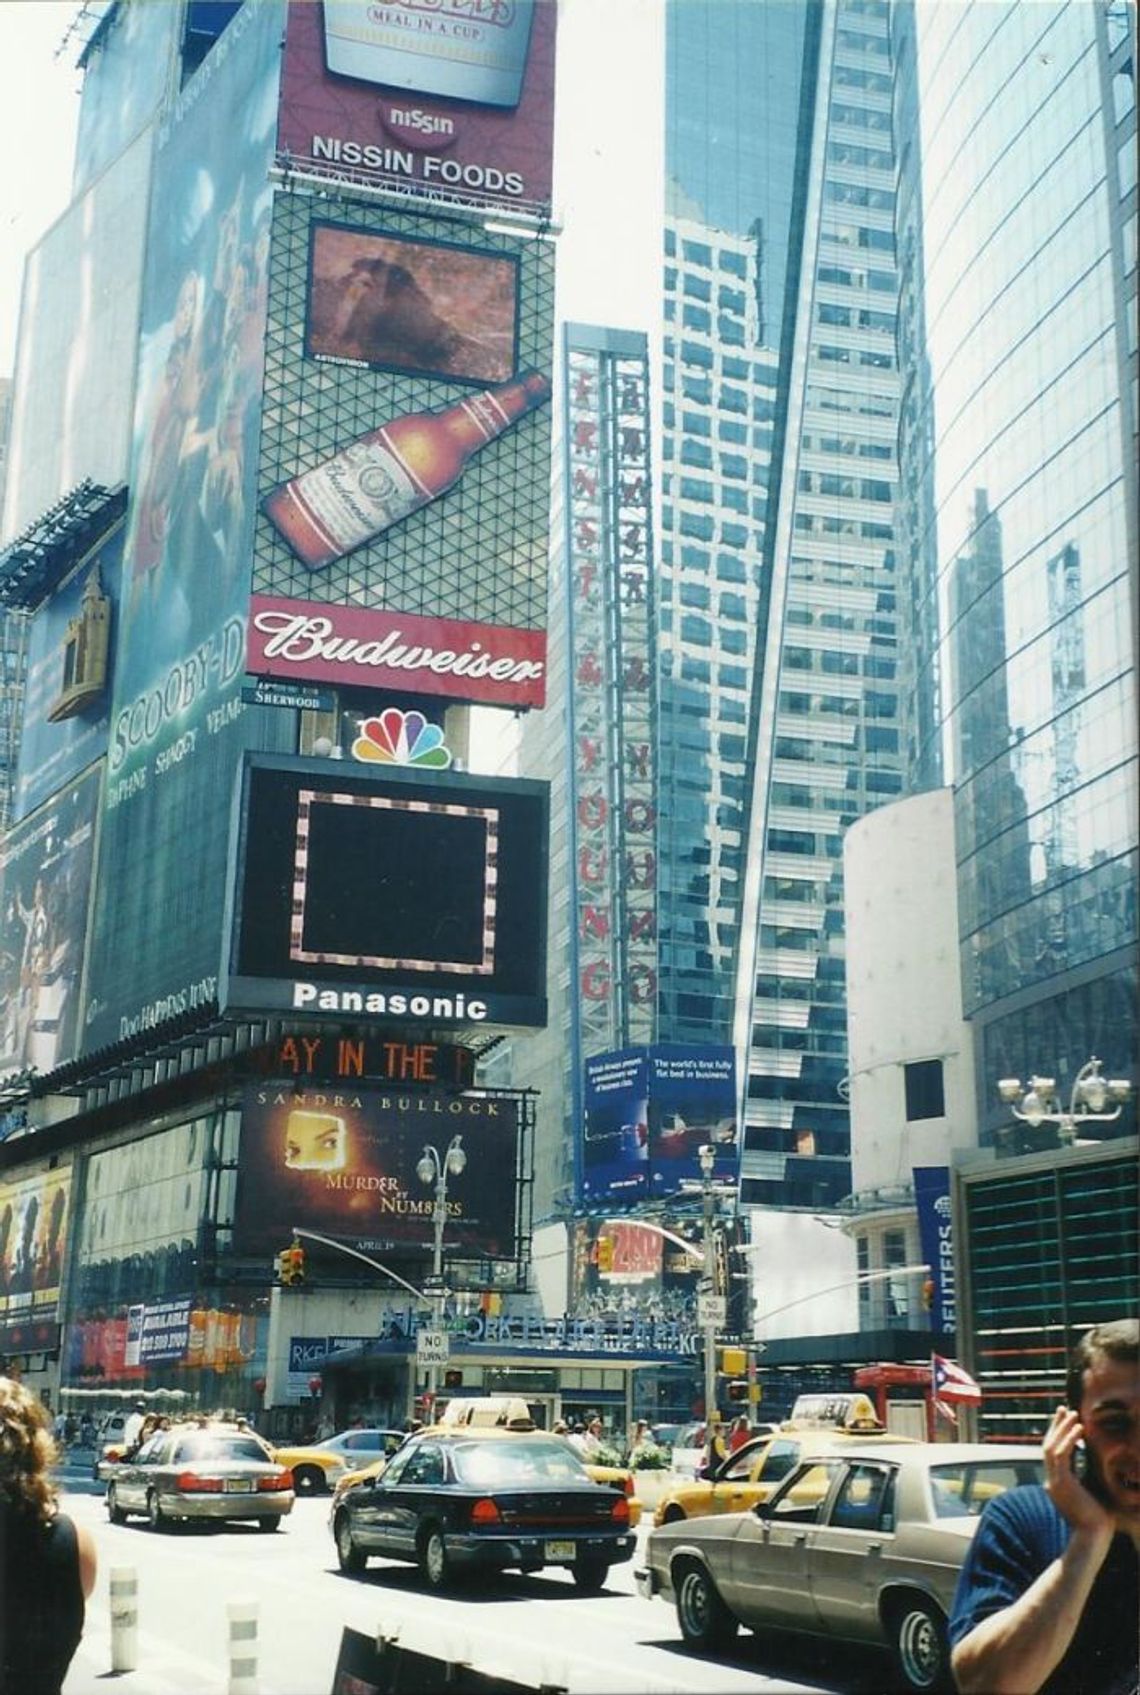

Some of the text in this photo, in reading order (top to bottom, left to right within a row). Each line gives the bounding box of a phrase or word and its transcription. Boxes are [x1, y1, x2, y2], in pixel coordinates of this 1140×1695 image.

[373, 9, 411, 27] MEAL
[418, 18, 433, 31] IN
[438, 23, 447, 33] A
[453, 25, 480, 39] CUP
[390, 107, 454, 134] nissin
[312, 134, 524, 195] NISSIN FOODS
[253, 610, 545, 683] Budweiser
[292, 982, 488, 1020] Panasonic
[338, 1039, 365, 1077] IN
[383, 1042, 438, 1080] THE
[258, 1092, 499, 1116] SANDRA BULLOCK
[326, 1176, 399, 1195] MURDER
[424, 1335, 442, 1347] NO
[418, 1351, 448, 1361] TURNS
